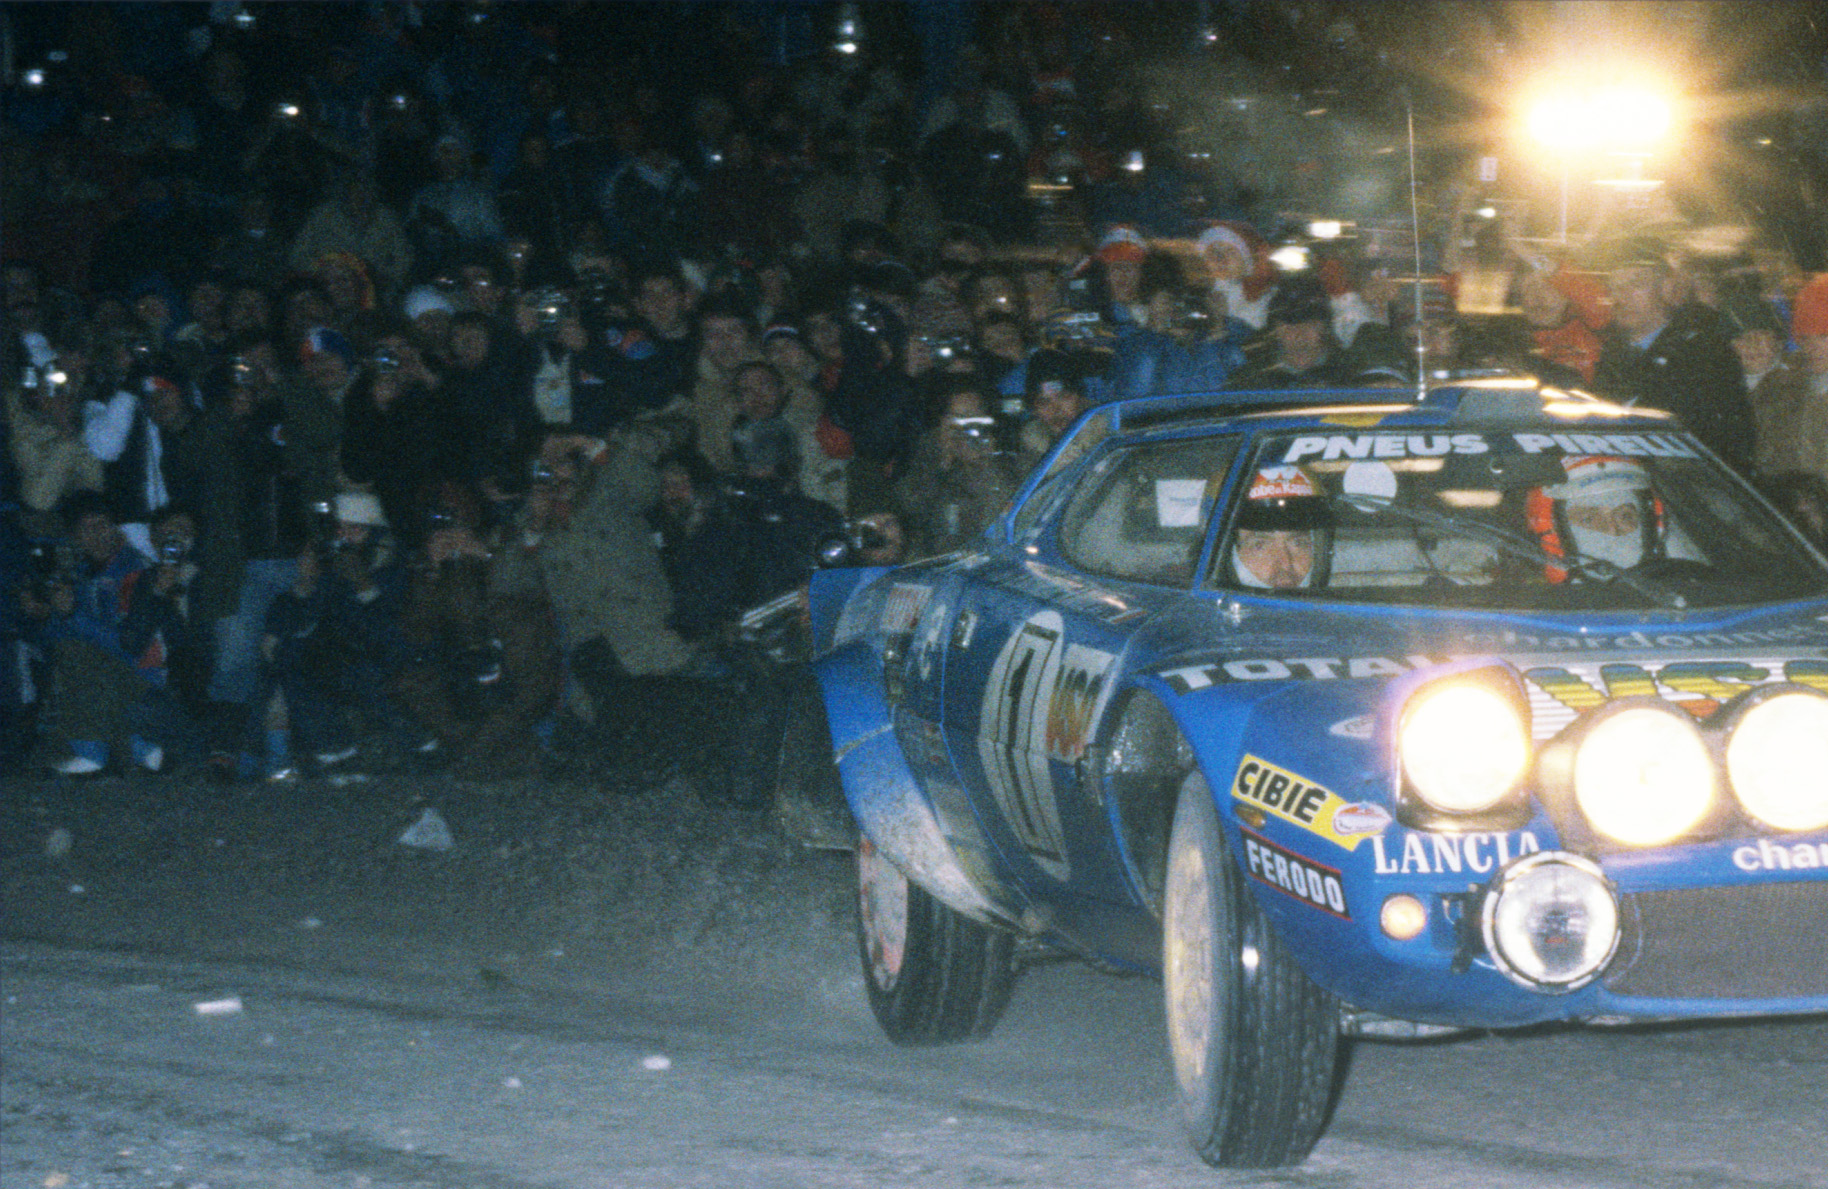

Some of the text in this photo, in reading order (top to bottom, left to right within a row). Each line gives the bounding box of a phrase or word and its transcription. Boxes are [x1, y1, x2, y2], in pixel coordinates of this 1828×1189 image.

[1284, 432, 1700, 462] PNEUS PIRELLI
[1247, 838, 1345, 913] FERODO
